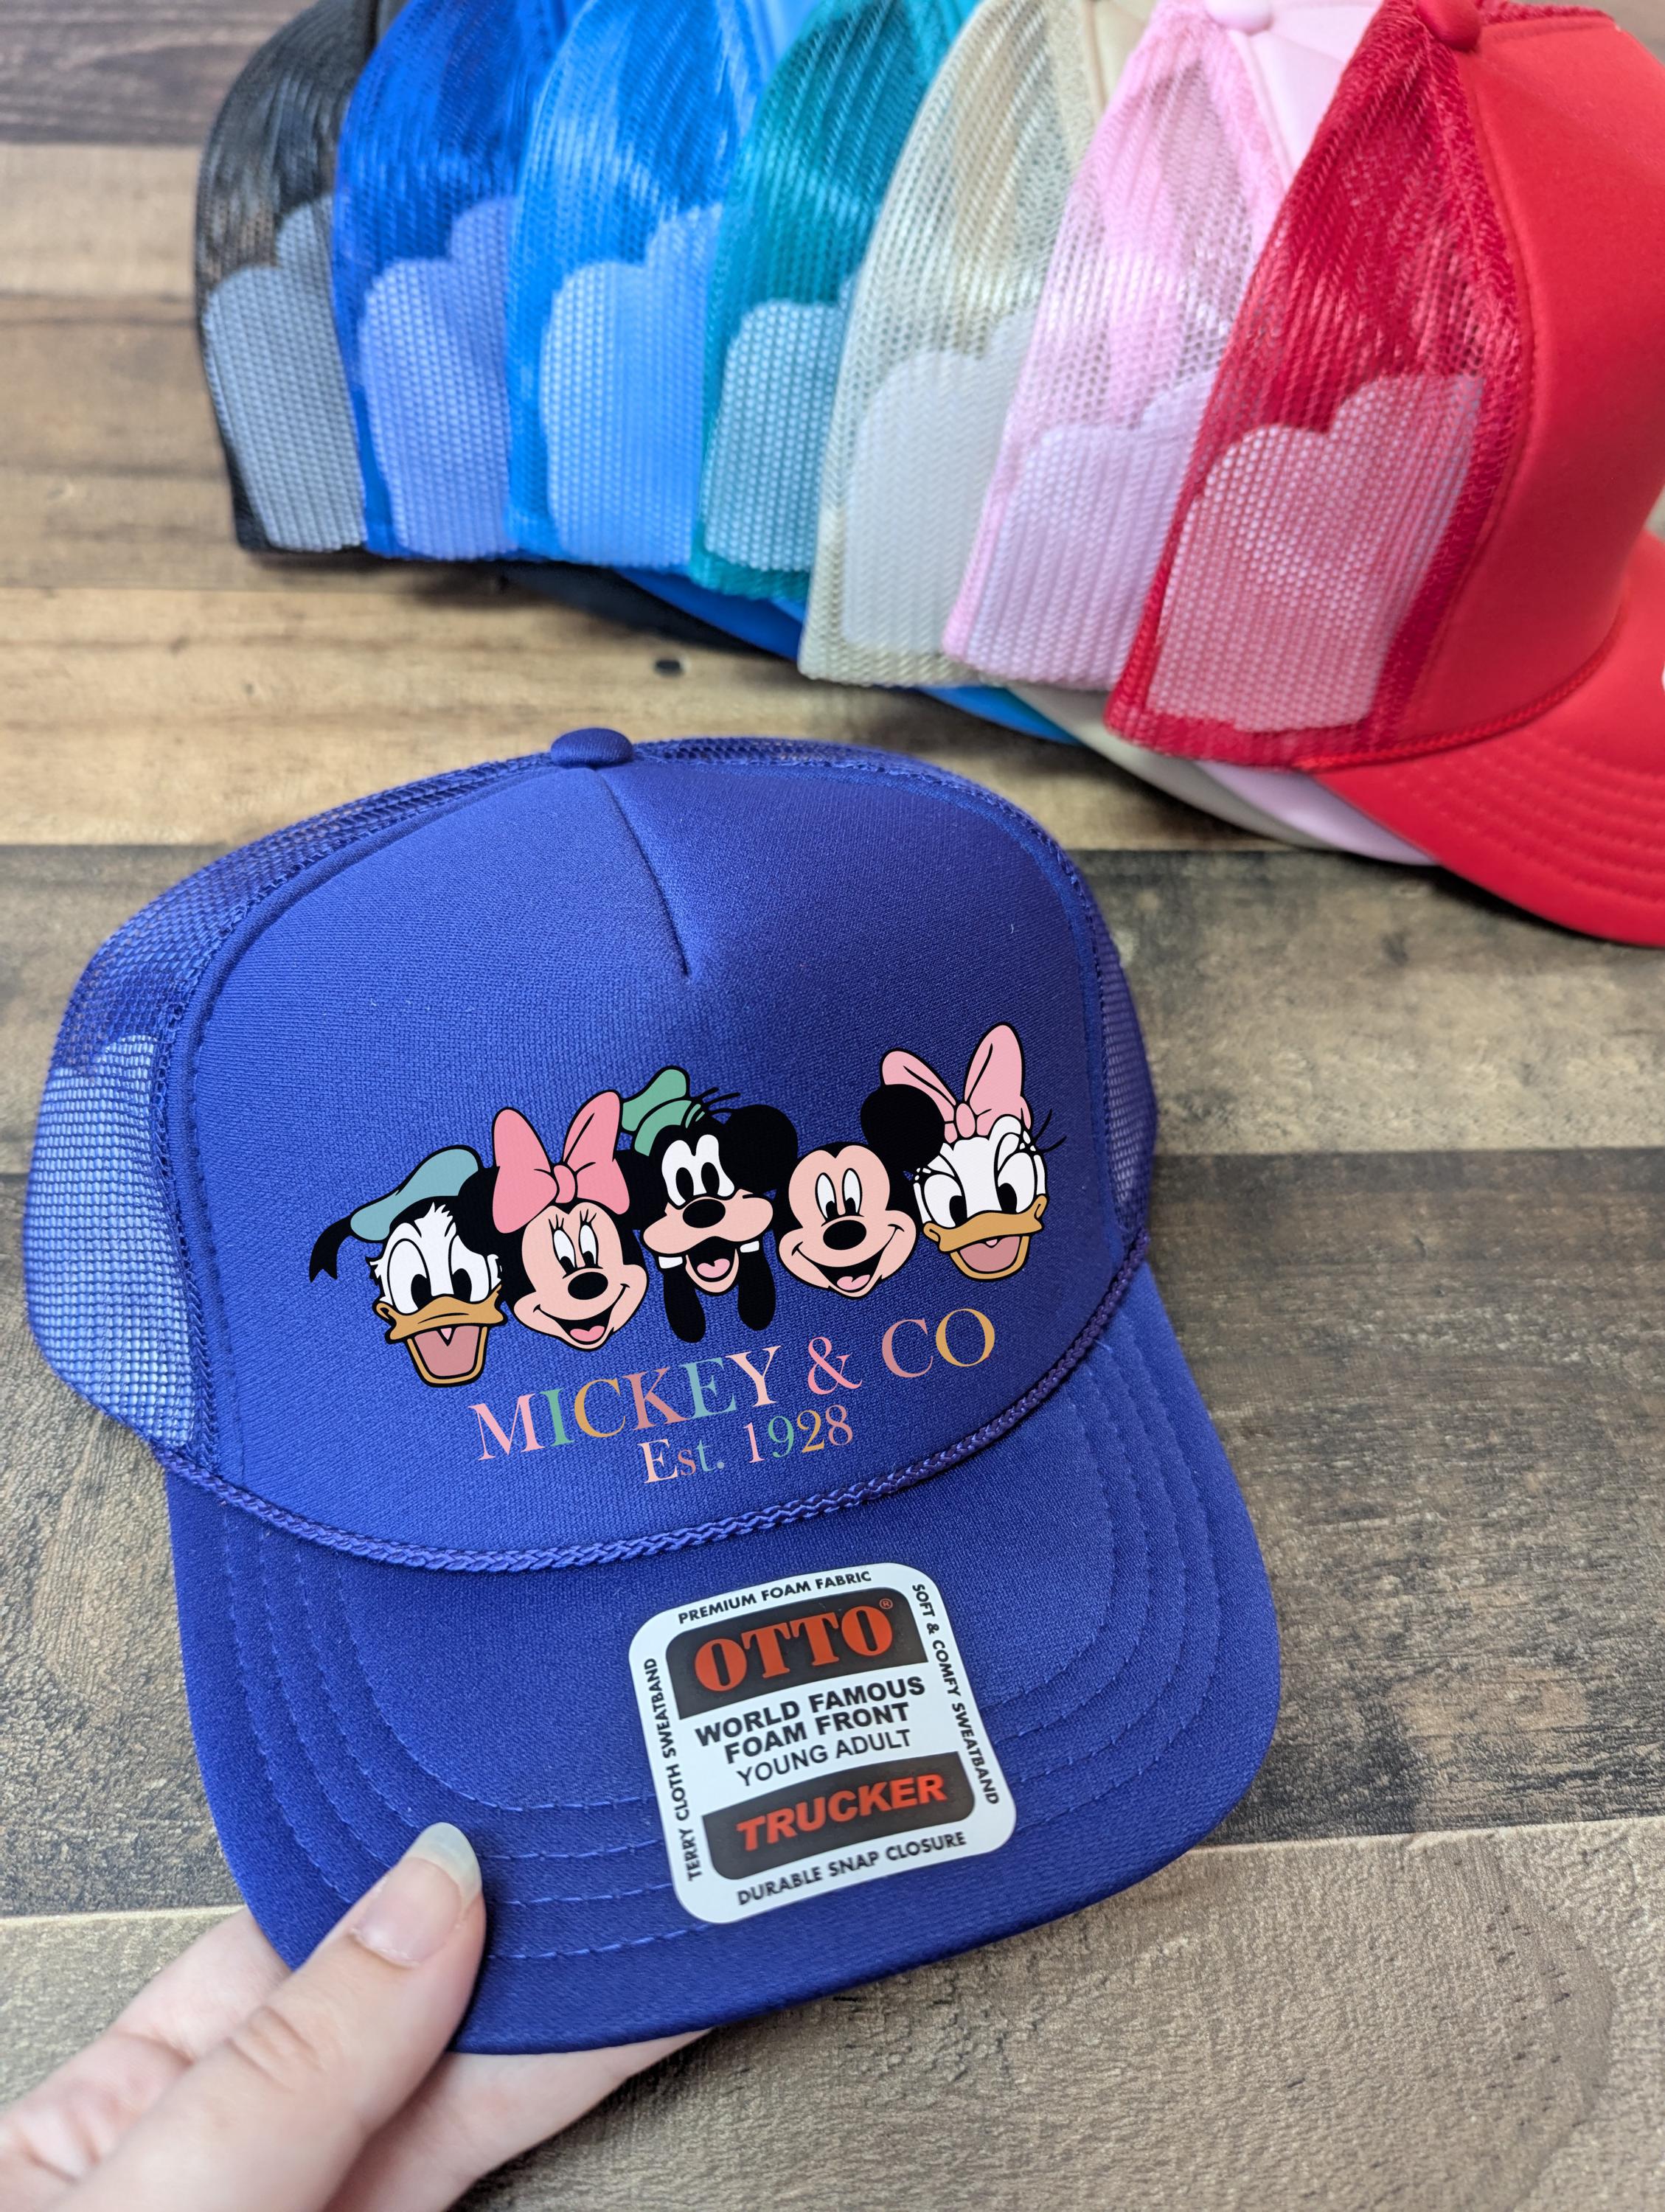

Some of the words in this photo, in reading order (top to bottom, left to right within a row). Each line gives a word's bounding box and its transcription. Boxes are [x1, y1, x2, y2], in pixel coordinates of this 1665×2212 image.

[469, 1345, 782, 1461] MICKEY
[807, 1337, 862, 1395] &
[883, 1308, 995, 1378] CO
[642, 1438, 726, 1484] Est.
[743, 1404, 853, 1464] 1928
[678, 1593, 757, 1624] PREMIUM
[761, 1580, 812, 1601] FOAM
[816, 1570, 872, 1590] FABRIC
[911, 1583, 936, 1626] SOFT
[927, 1624, 940, 1635] &
[932, 1639, 961, 1697] COMFY
[643, 1657, 677, 1759] SWEATBAND
[695, 1700, 800, 1747] WORLD
[811, 1676, 925, 1714] FAMOUS
[724, 1725, 807, 1764] FOAM
[817, 1702, 909, 1736] FRONT
[737, 1745, 827, 1787] YOUNG
[835, 1728, 911, 1759] ADULT
[951, 1702, 1000, 1805] SWEATBAND
[665, 1763, 689, 1821] CLOTH
[737, 1773, 948, 1851] TRUCKER
[681, 1827, 703, 1882] TERRY
[737, 1872, 823, 1905] DURABLE
[828, 1851, 880, 1877] SNAP
[886, 1831, 967, 1861] CLOSURE
